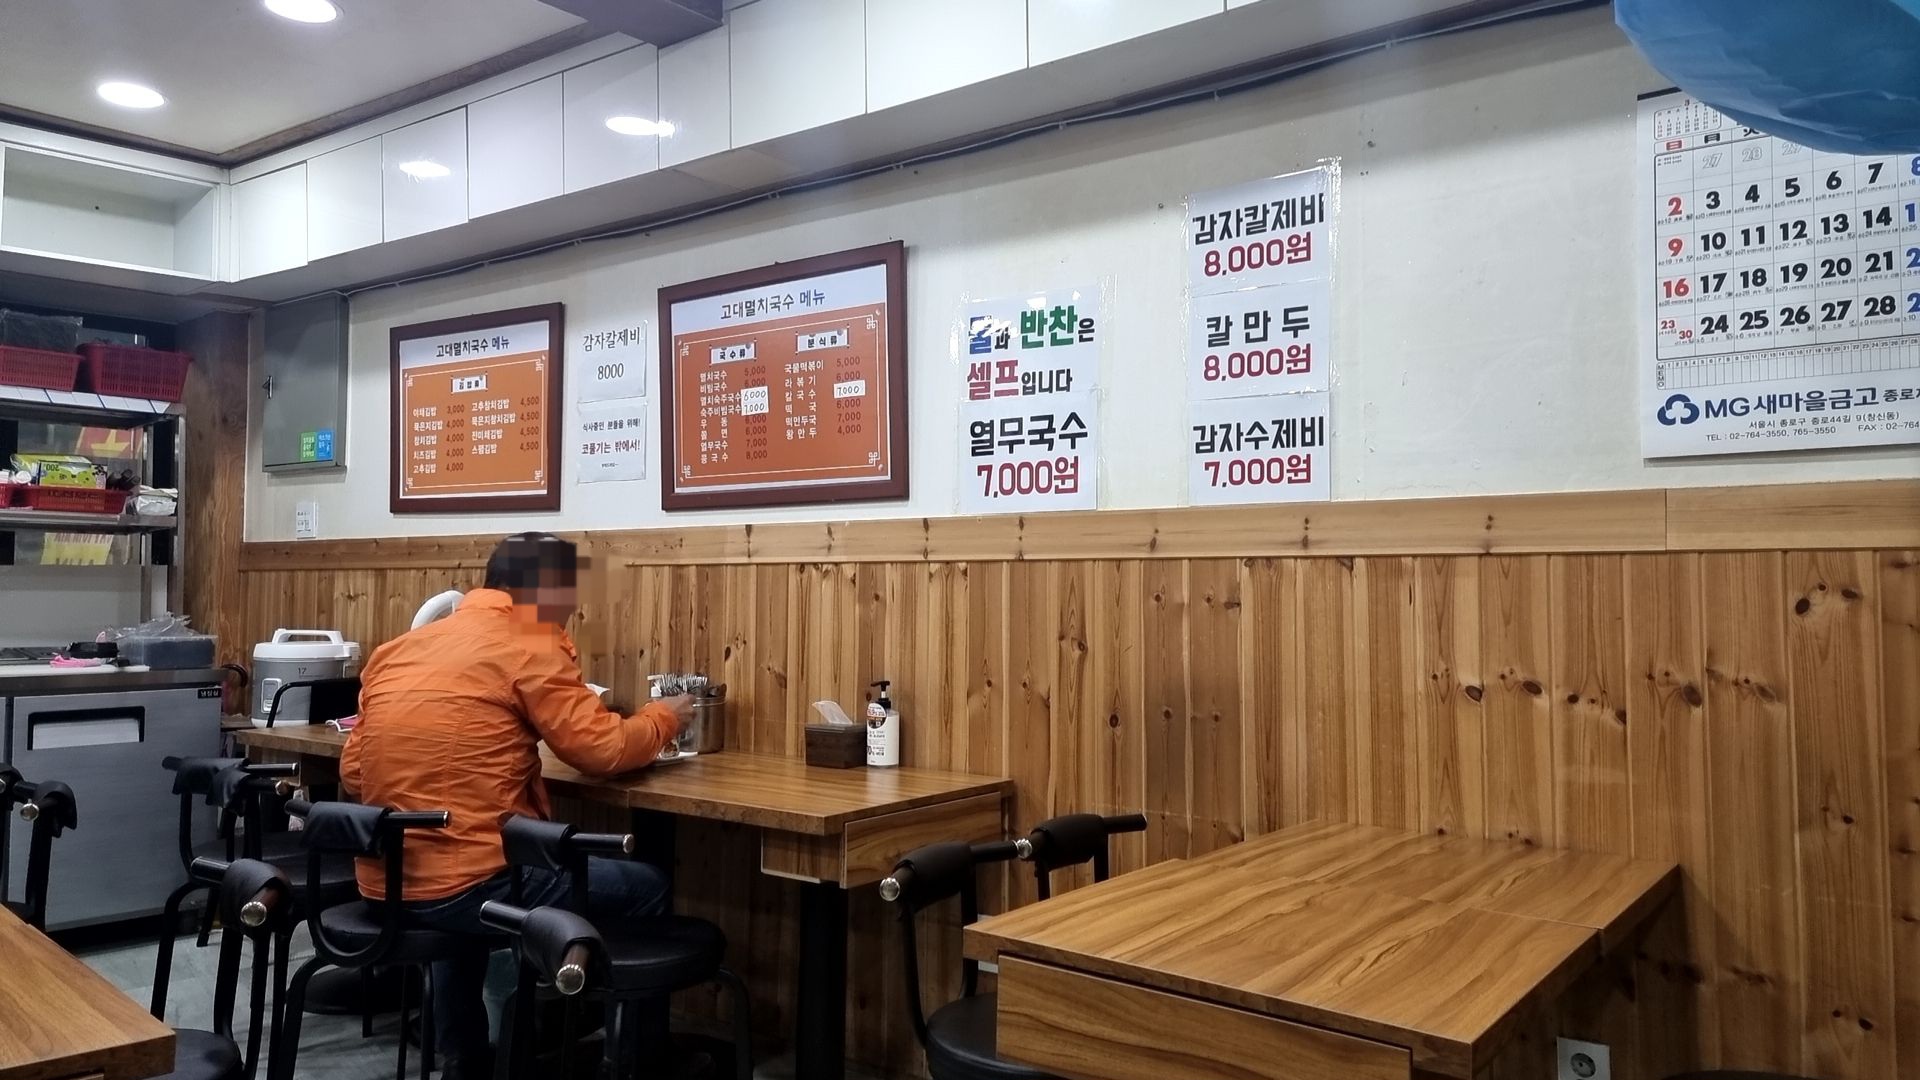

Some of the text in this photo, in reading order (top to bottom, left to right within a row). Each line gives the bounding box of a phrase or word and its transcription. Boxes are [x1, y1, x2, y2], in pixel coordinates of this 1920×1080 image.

[1702, 153, 1722, 169] 27
[1742, 146, 1762, 162] 28
[1668, 197, 1683, 217] 2
[1706, 191, 1721, 209] 3
[1745, 184, 1760, 203] 4
[1785, 177, 1800, 198] 5
[1826, 170, 1842, 190] 6
[1868, 162, 1884, 184] 7
[1192, 192, 1325, 245] 감자칼제비
[1668, 238, 1683, 257] 9
[1701, 232, 1727, 252] 10
[1741, 225, 1765, 247] 11
[1779, 220, 1808, 241] 12
[1820, 213, 1850, 235] 13
[1863, 206, 1892, 229] 14
[1905, 202, 1920, 223] 1
[1663, 278, 1689, 298] 16
[1700, 272, 1728, 294] 17
[1740, 268, 1767, 289] 18
[1780, 262, 1809, 284] 19
[1820, 257, 1852, 279] 20
[1865, 250, 1893, 274] 21
[720, 289, 826, 320] 고대멸치국수 메뉴
[1661, 320, 1676, 330] 23
[1679, 330, 1693, 340] 30
[1700, 314, 1729, 336] 24
[1740, 309, 1769, 331] 25
[1779, 305, 1811, 327] 26
[1820, 300, 1852, 322] 27
[1864, 295, 1896, 317] 28
[582, 326, 641, 352] 감자칼제비
[1020, 305, 1095, 349] 반찬은
[436, 336, 510, 357] 고대멸치국수 메뉴
[597, 362, 624, 380] 8000
[700, 370, 727, 382] 멸치국수
[784, 360, 824, 374] 국물떡볶이
[967, 359, 1073, 400] 셀프입니다
[700, 381, 727, 394] 비빔국수
[700, 392, 741, 406] 멸치숙주국수
[1705, 397, 1750, 419] MG
[1753, 387, 1879, 415] 새마을금고
[583, 421, 604, 432] 식사중인
[786, 415, 817, 427] 떡만두국
[970, 411, 1088, 457] 열무국수
[1749, 420, 1775, 429] 서울시
[1793, 426, 1836, 436] 765-3550
[1858, 424, 1877, 432] FAX
[582, 439, 640, 455] 코풀기는 밖에서!
[1193, 416, 1324, 454] 감자수제비
[977, 456, 1079, 498] 7,000원
